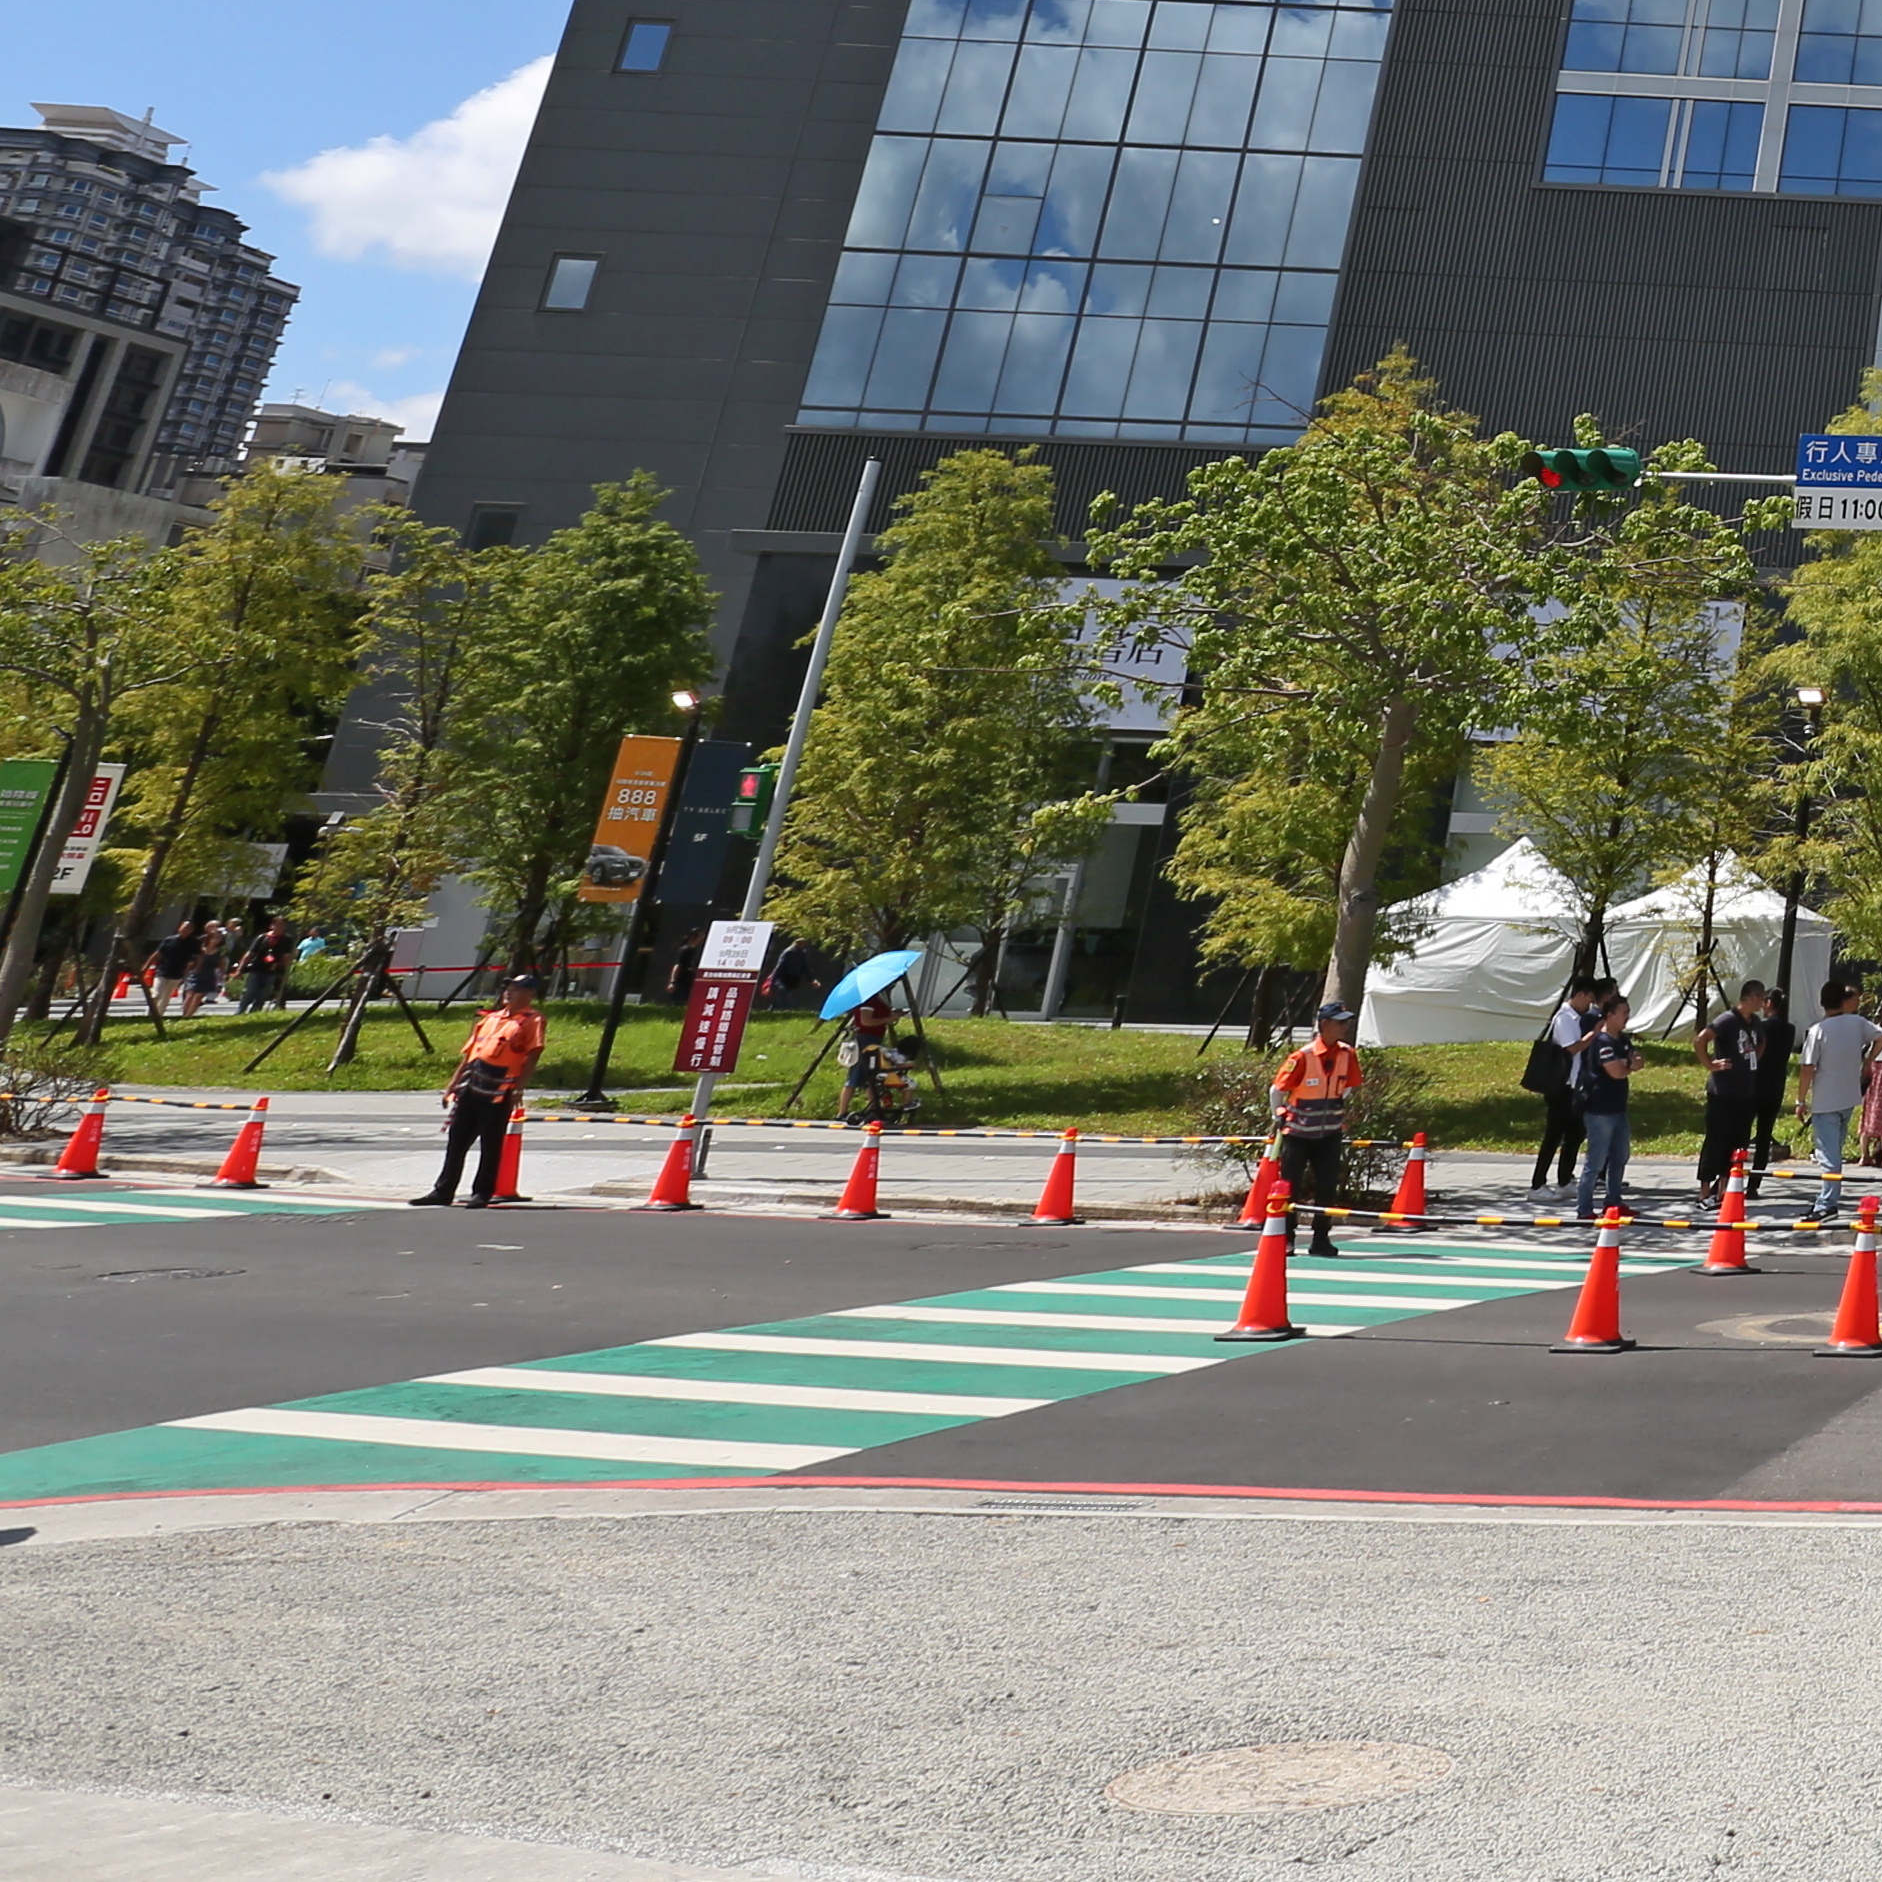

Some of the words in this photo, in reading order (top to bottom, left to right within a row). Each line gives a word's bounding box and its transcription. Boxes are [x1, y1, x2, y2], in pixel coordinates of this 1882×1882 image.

[1802, 468, 1854, 482] Exclusive
[1796, 496, 1834, 520] 假日
[617, 788, 657, 805] 888
[607, 807, 657, 822] 抽汽車
[698, 807, 731, 815] SELEC
